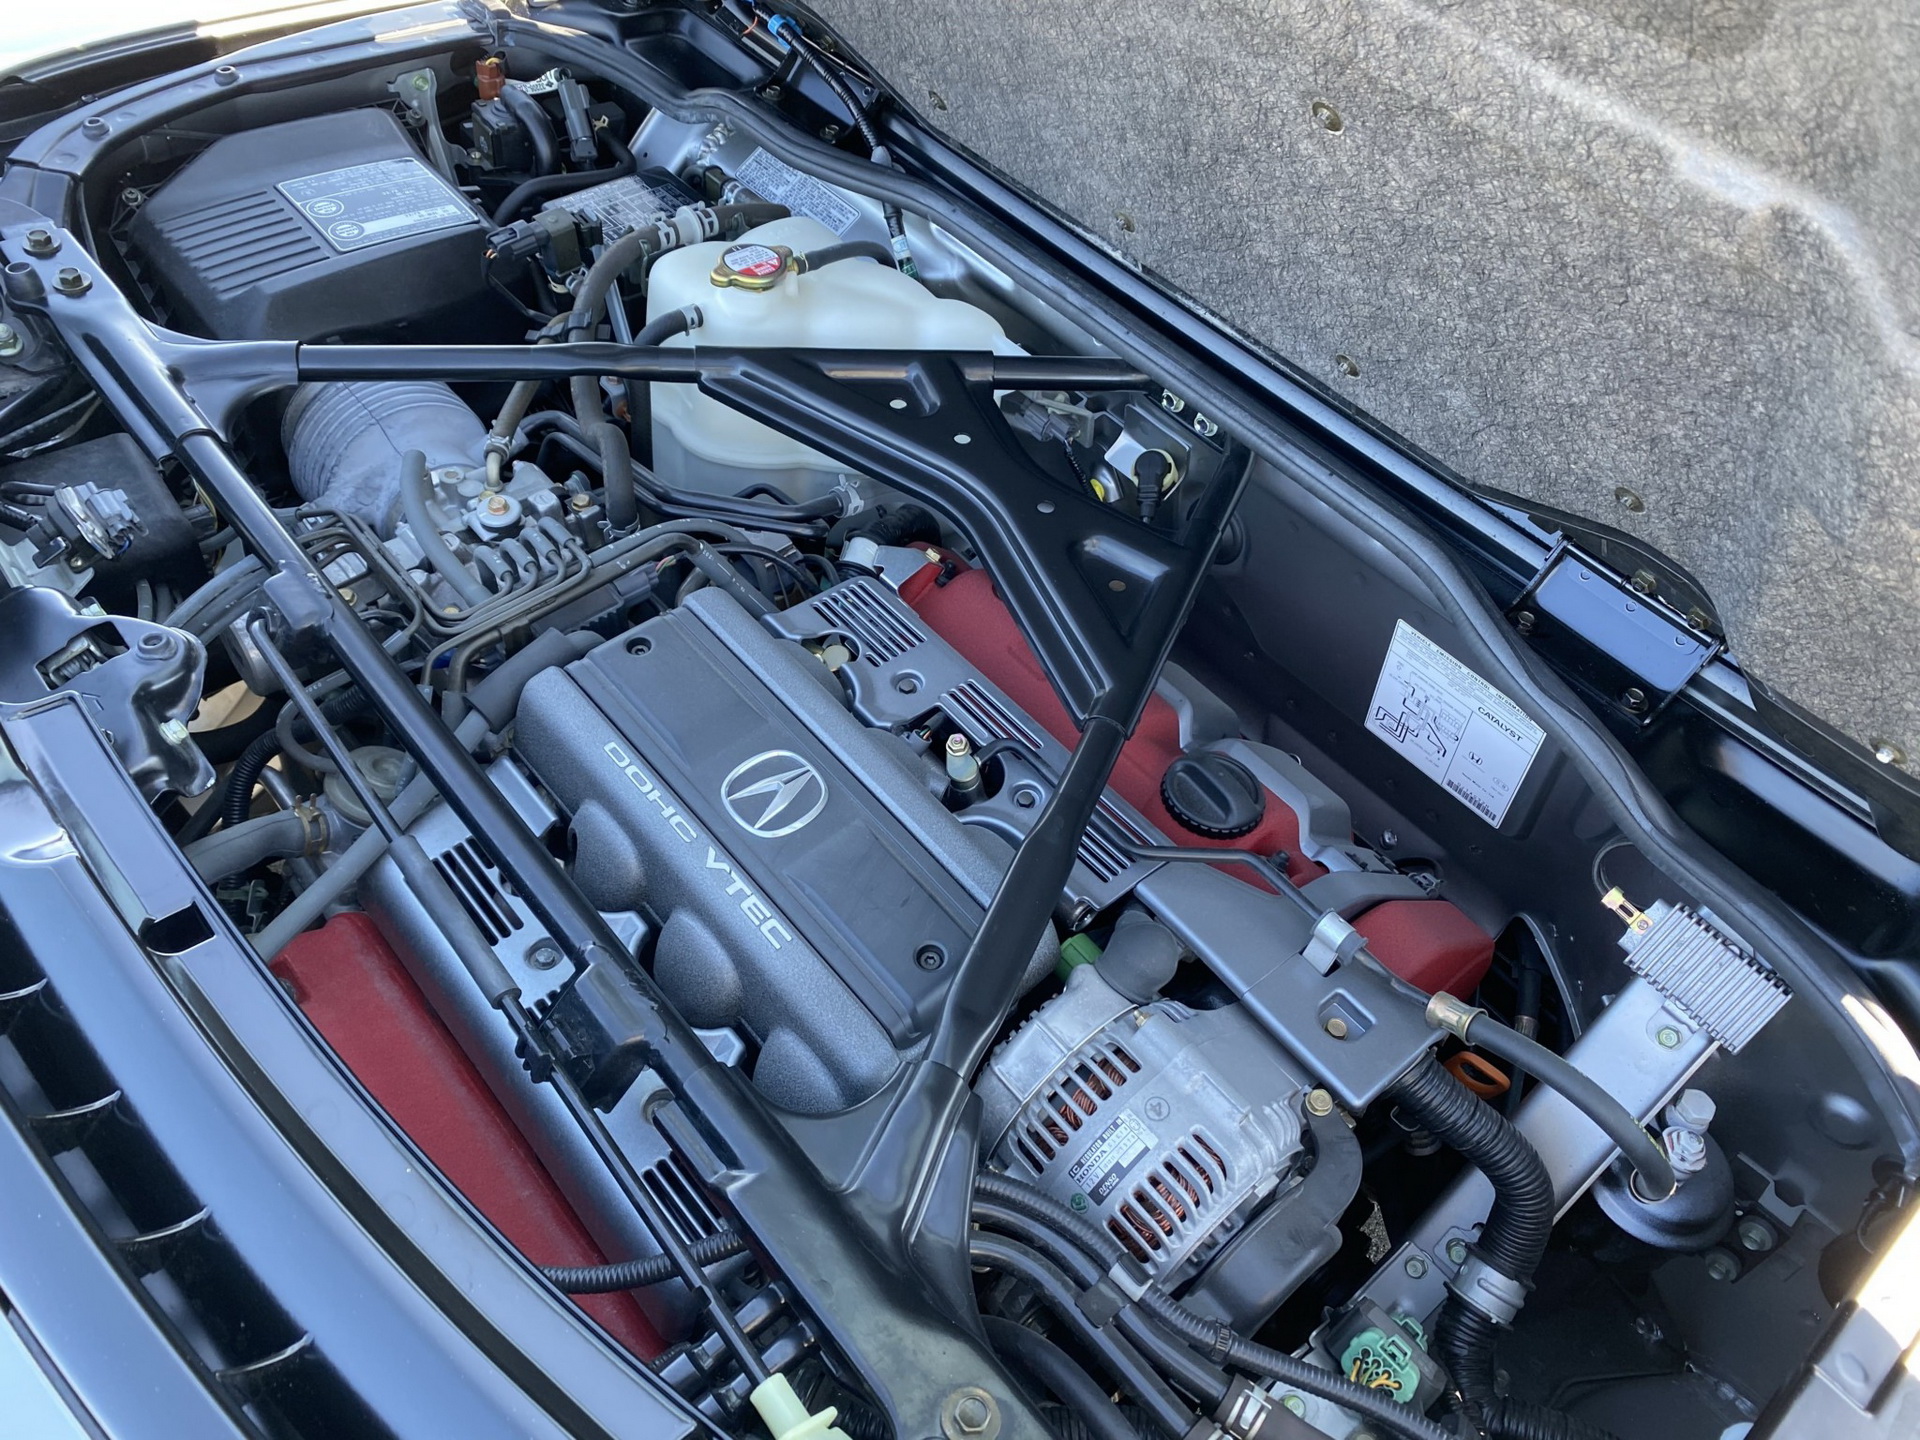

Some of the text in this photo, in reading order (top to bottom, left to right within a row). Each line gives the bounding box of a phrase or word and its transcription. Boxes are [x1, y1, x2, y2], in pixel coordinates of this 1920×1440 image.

[1436, 649, 1462, 670] EMISSION
[1466, 671, 1490, 690] CONTROL
[1477, 706, 1523, 742] CATALYST
[603, 741, 793, 950] DOHC VTEC
[1069, 1164, 1081, 1177] IC
[1080, 1139, 1103, 1164] REGULATOR
[1102, 1125, 1116, 1140] BUILT
[1076, 1149, 1108, 1184] HONDA
[1098, 1173, 1117, 1195] DENSO
